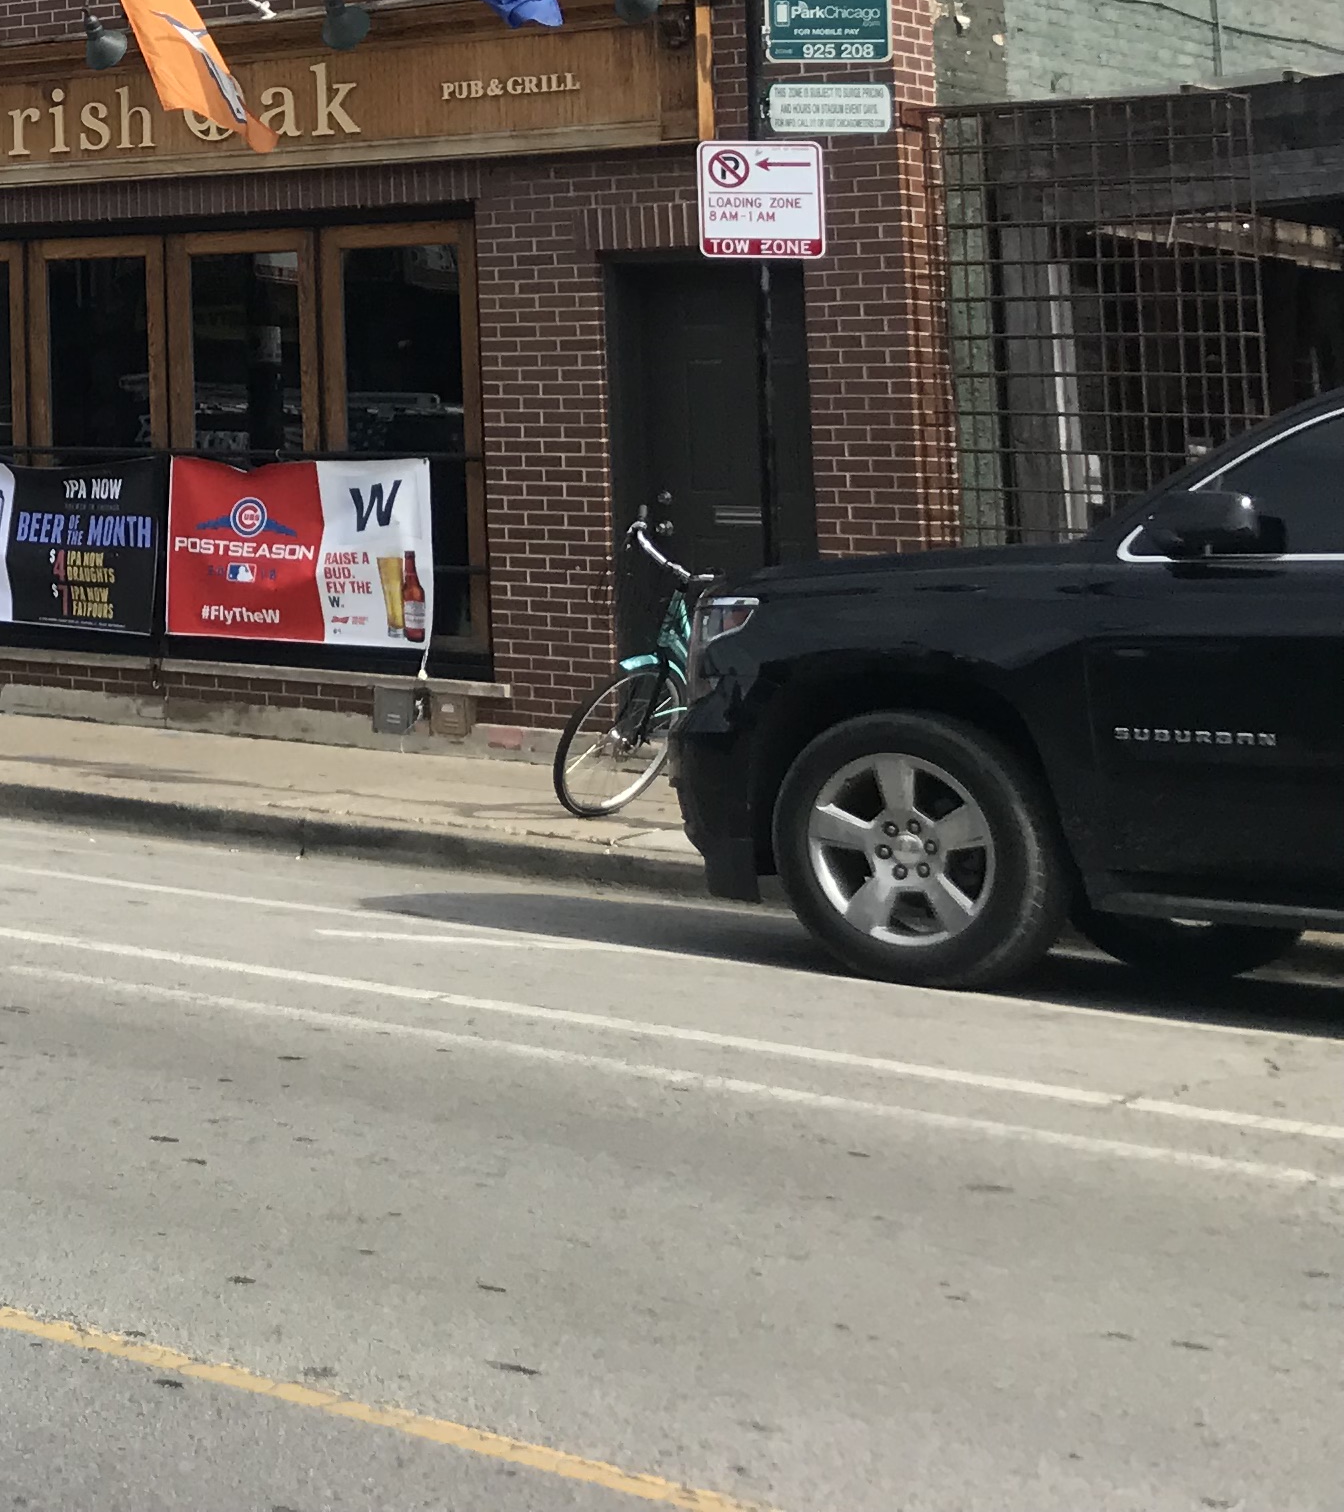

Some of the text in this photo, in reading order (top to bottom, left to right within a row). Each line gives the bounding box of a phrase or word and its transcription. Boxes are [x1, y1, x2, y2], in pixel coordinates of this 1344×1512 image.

[791, 5, 881, 21] ParkChicago
[793, 28, 811, 36] FOR
[812, 28, 843, 36] MOBILE
[802, 44, 836, 58] 925
[840, 44, 874, 58] 208
[441, 80, 485, 100] PUB
[506, 72, 581, 95] GRILL
[708, 197, 802, 208] LOADING ZONE
[710, 239, 812, 254] TOW ZONE
[63, 478, 123, 500] IPA NOW
[348, 479, 403, 532] W
[16, 511, 152, 548] BEER OF THE MONTH
[174, 536, 315, 561] POSTSEASON
[66, 550, 81, 566] IPA
[83, 551, 104, 567] NOW
[324, 551, 370, 565] RAISE A
[66, 567, 116, 583] DRAUGHTS
[324, 566, 356, 580] BUD.
[70, 585, 87, 600] IPA
[87, 586, 109, 602] NOW
[326, 581, 373, 595] FLY THE
[328, 595, 345, 608] W.
[72, 601, 114, 619] FATPOURS
[201, 604, 280, 625] #FlyTheW
[1114, 727, 1278, 746] SUBURBAN
